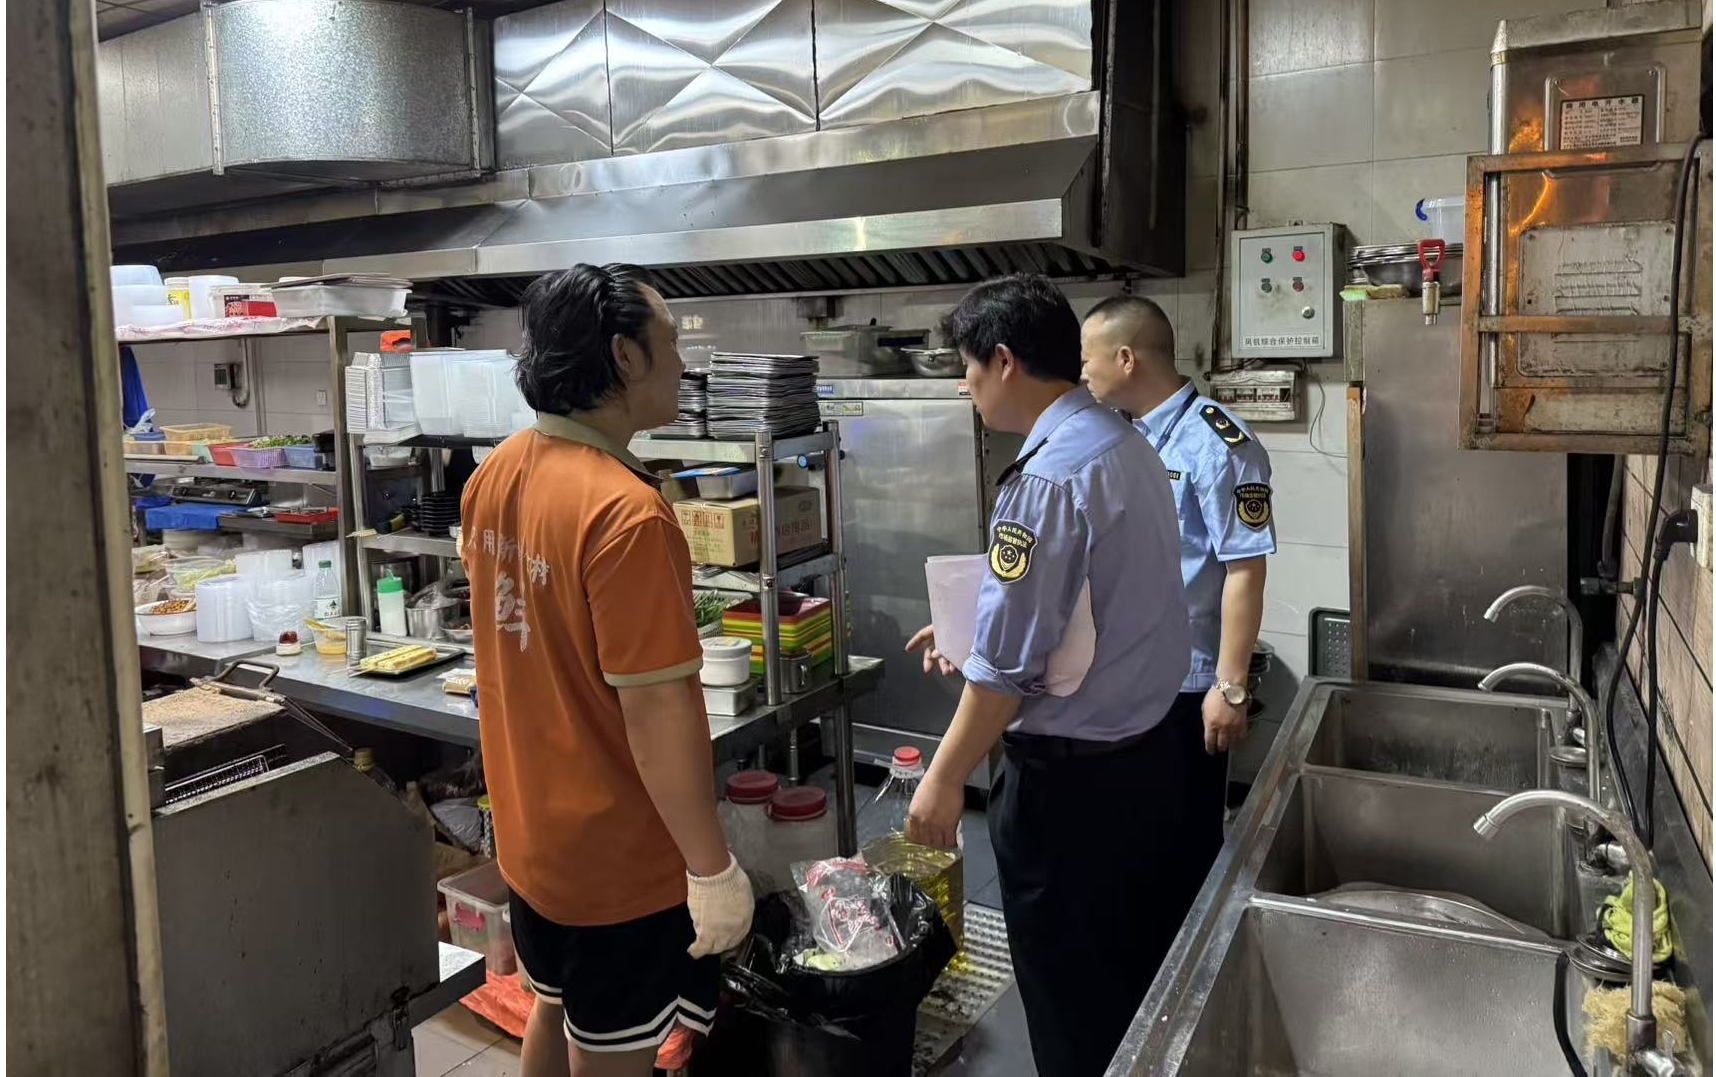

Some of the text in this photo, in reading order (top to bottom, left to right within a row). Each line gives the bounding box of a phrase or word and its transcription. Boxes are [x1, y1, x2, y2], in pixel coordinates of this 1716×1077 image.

[1245, 336, 1319, 346] 风机综合保护控制箱
